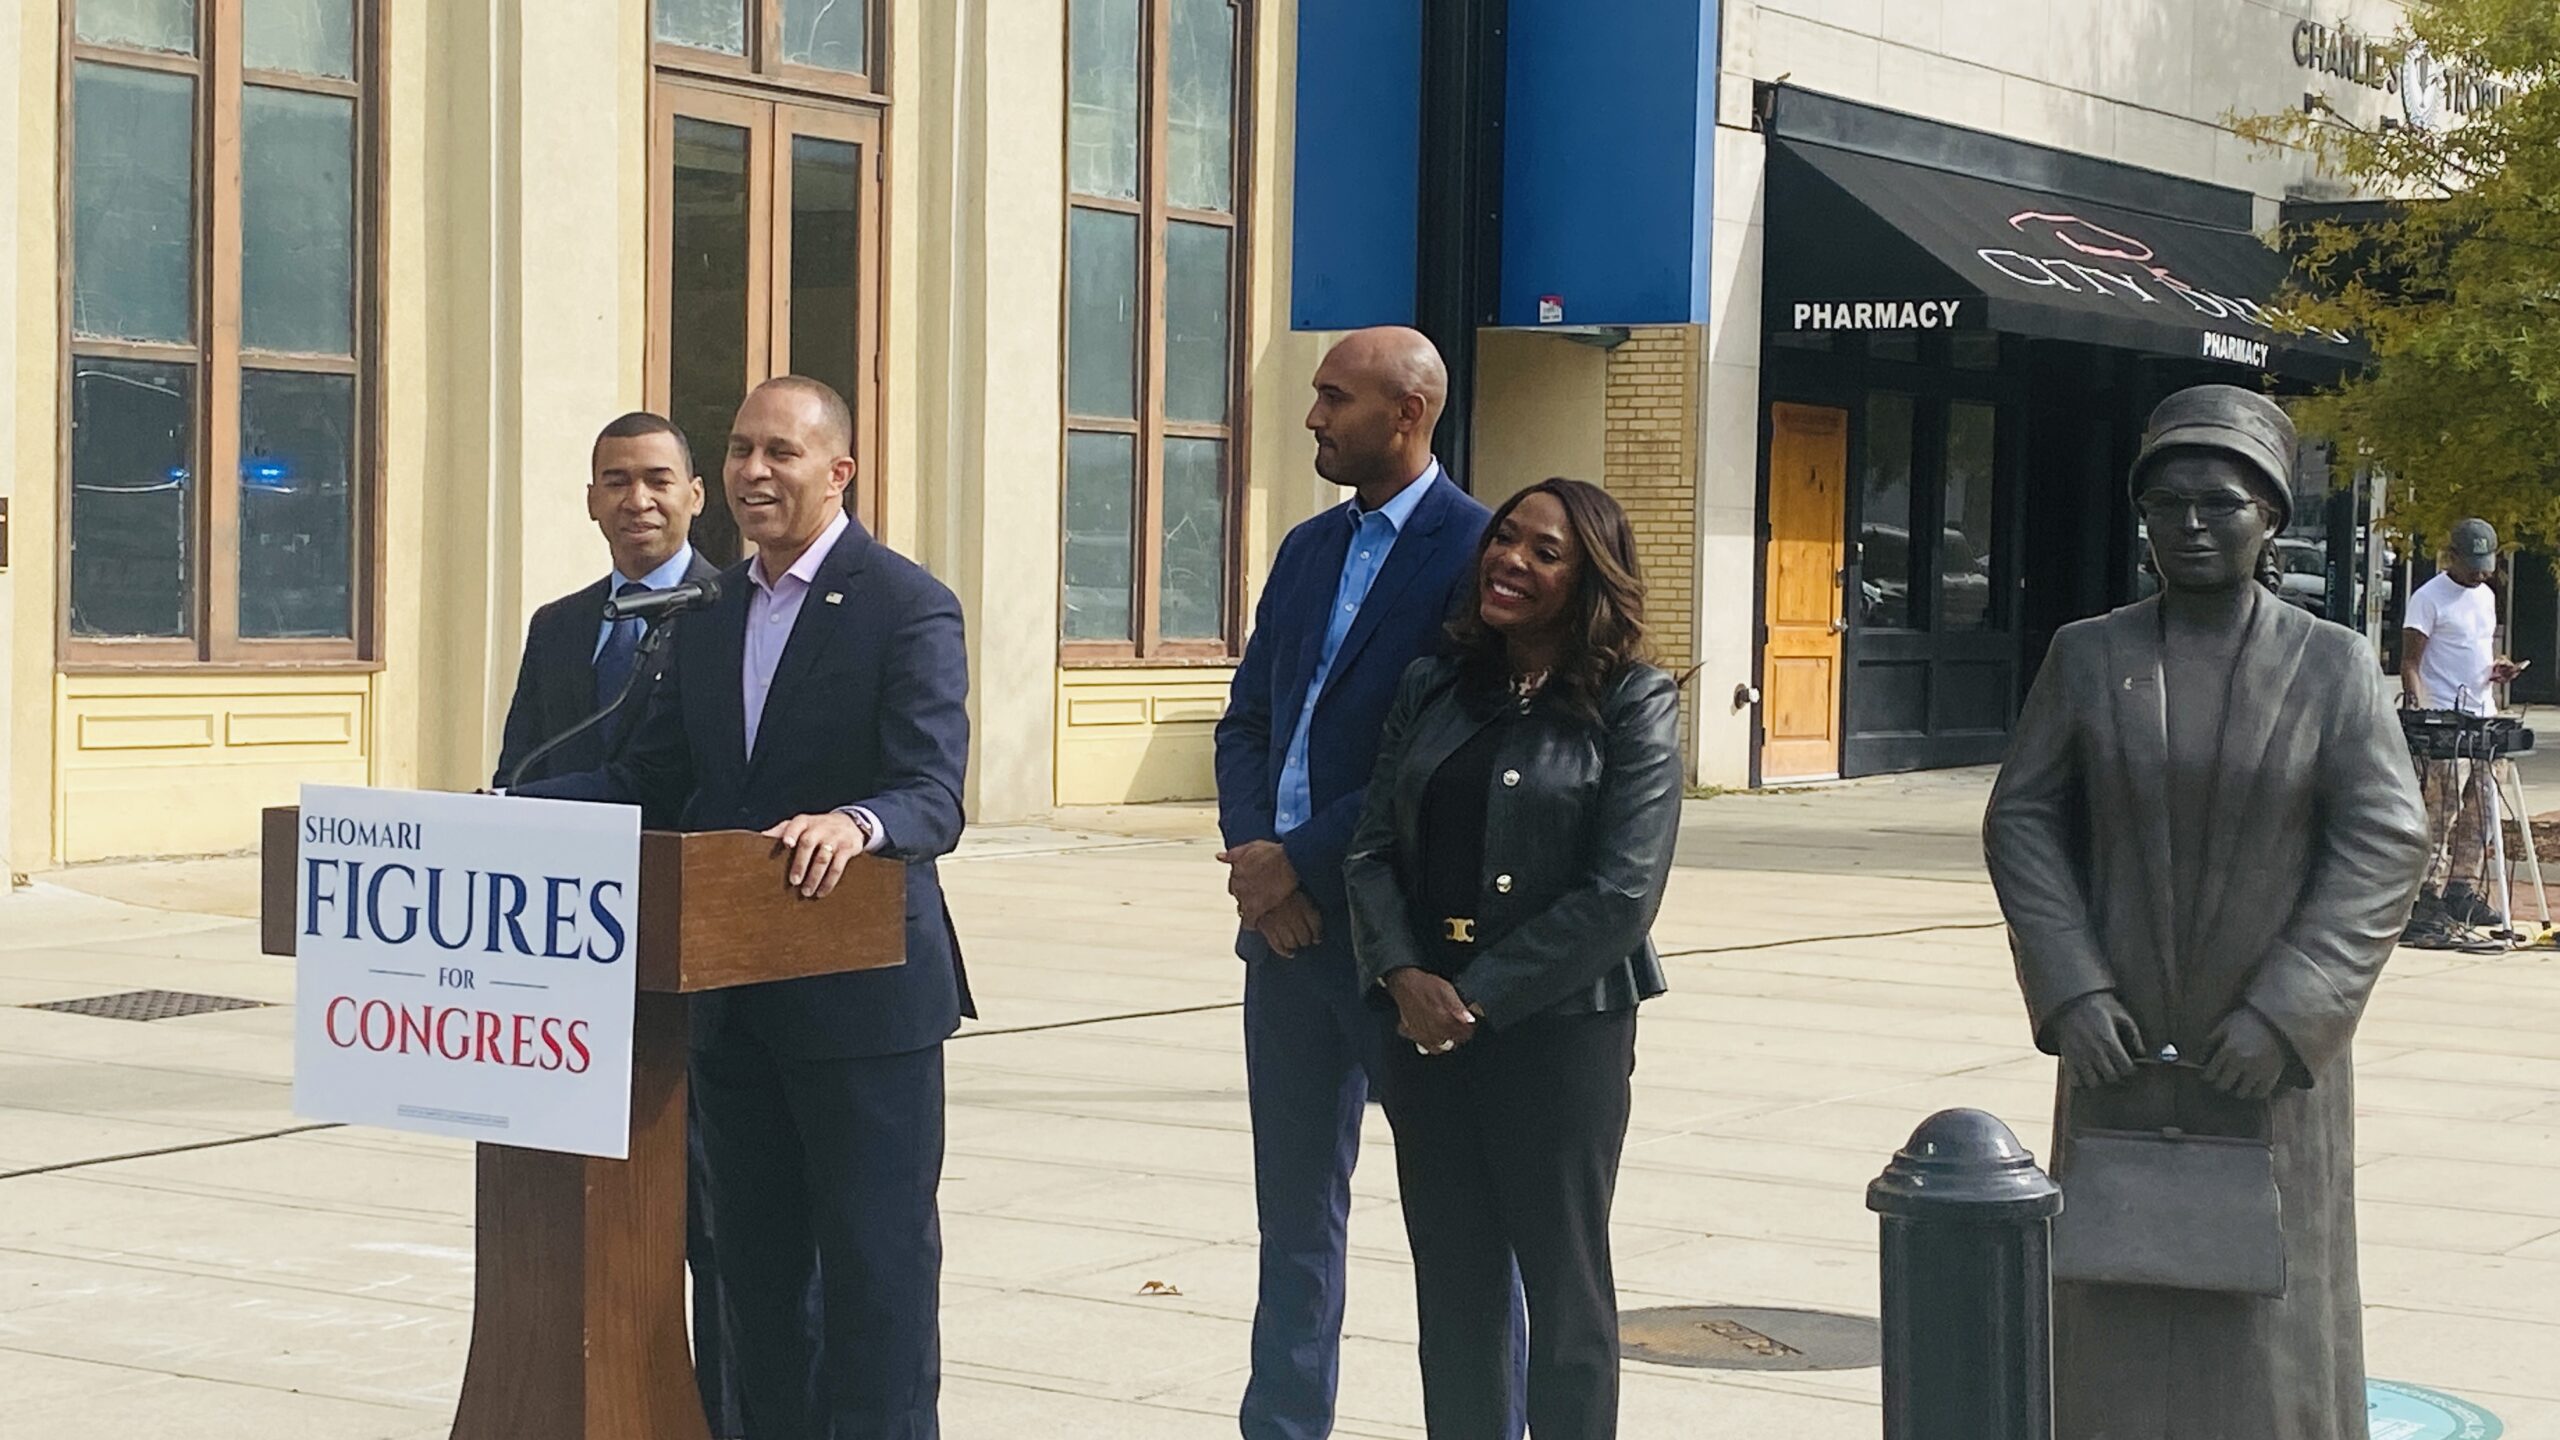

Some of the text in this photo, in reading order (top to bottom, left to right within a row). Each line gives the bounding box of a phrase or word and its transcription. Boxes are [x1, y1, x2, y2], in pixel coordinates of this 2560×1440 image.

[2292, 19, 2398, 95] CHARLIES
[1977, 248, 2161, 304] CITY
[1794, 300, 1961, 330] PHARMACY
[2202, 331, 2269, 368] PHARMACY
[304, 815, 422, 850] SHOMARI
[303, 857, 625, 963] FIGURES
[438, 967, 475, 989] FOR
[326, 996, 591, 1073] CONGRESS
